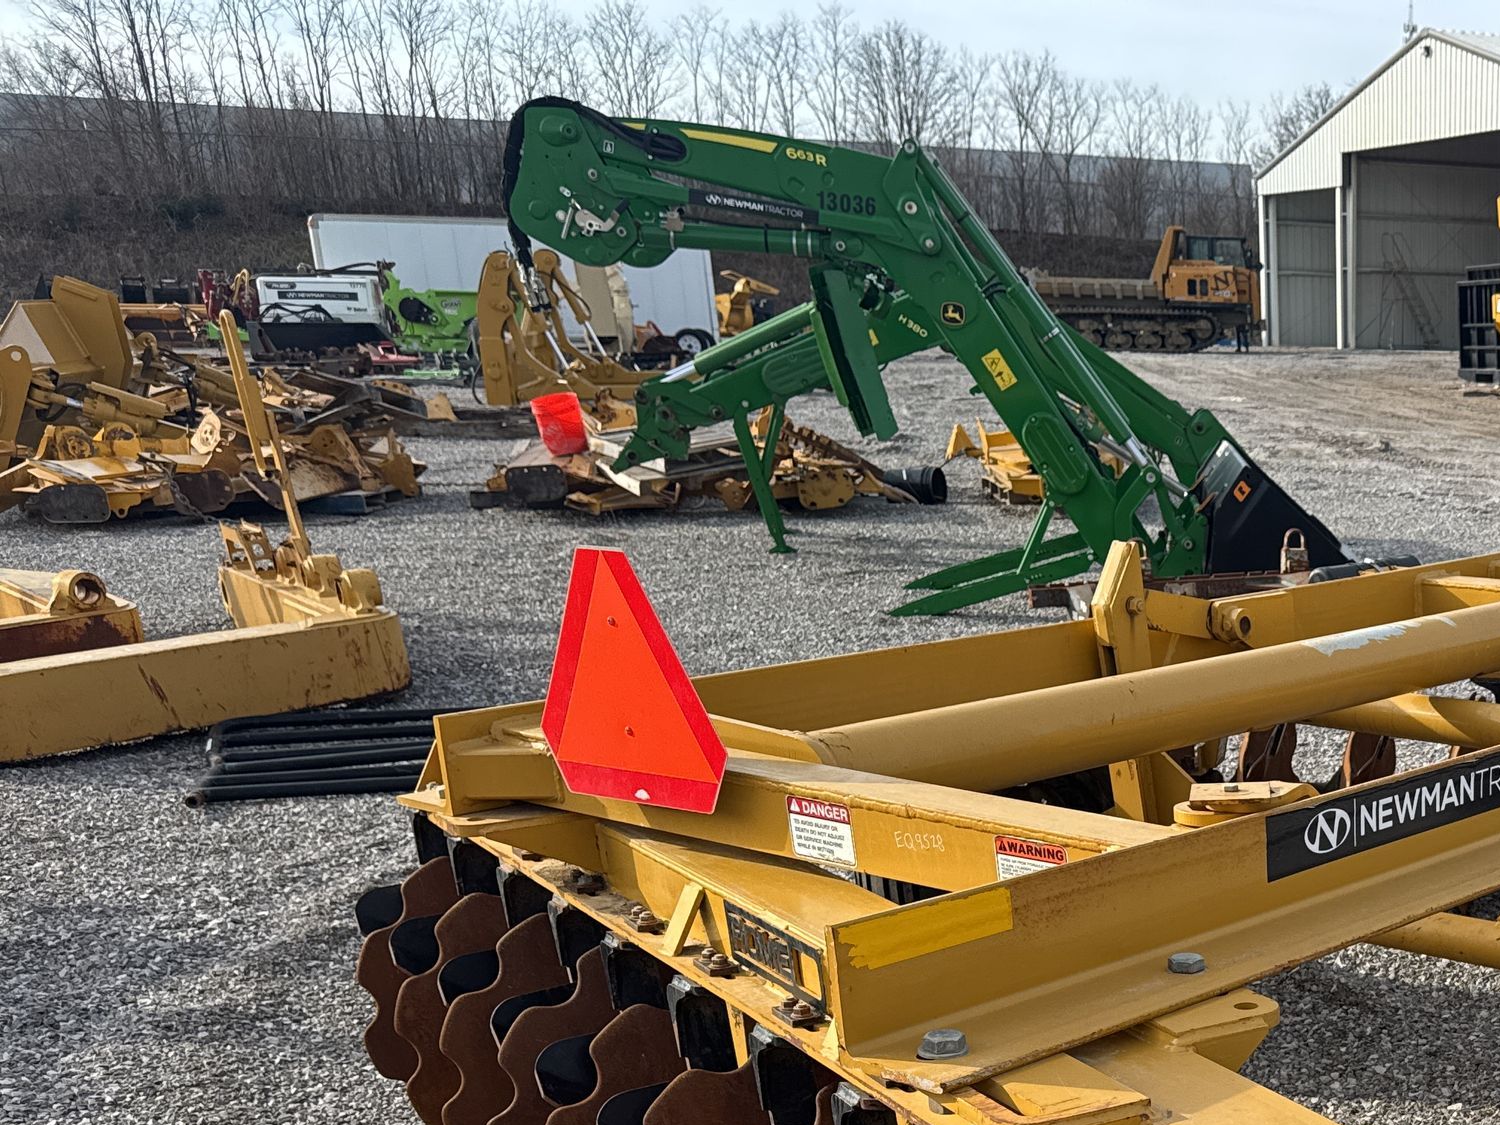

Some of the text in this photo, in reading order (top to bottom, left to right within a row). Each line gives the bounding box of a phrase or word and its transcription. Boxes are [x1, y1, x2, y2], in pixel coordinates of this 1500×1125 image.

[786, 147, 827, 167] 663R
[723, 198, 803, 218] NEWMANTRACTOR
[817, 191, 876, 216] 13036
[801, 801, 849, 822] DANGER
[1007, 841, 1065, 861] WARNING
